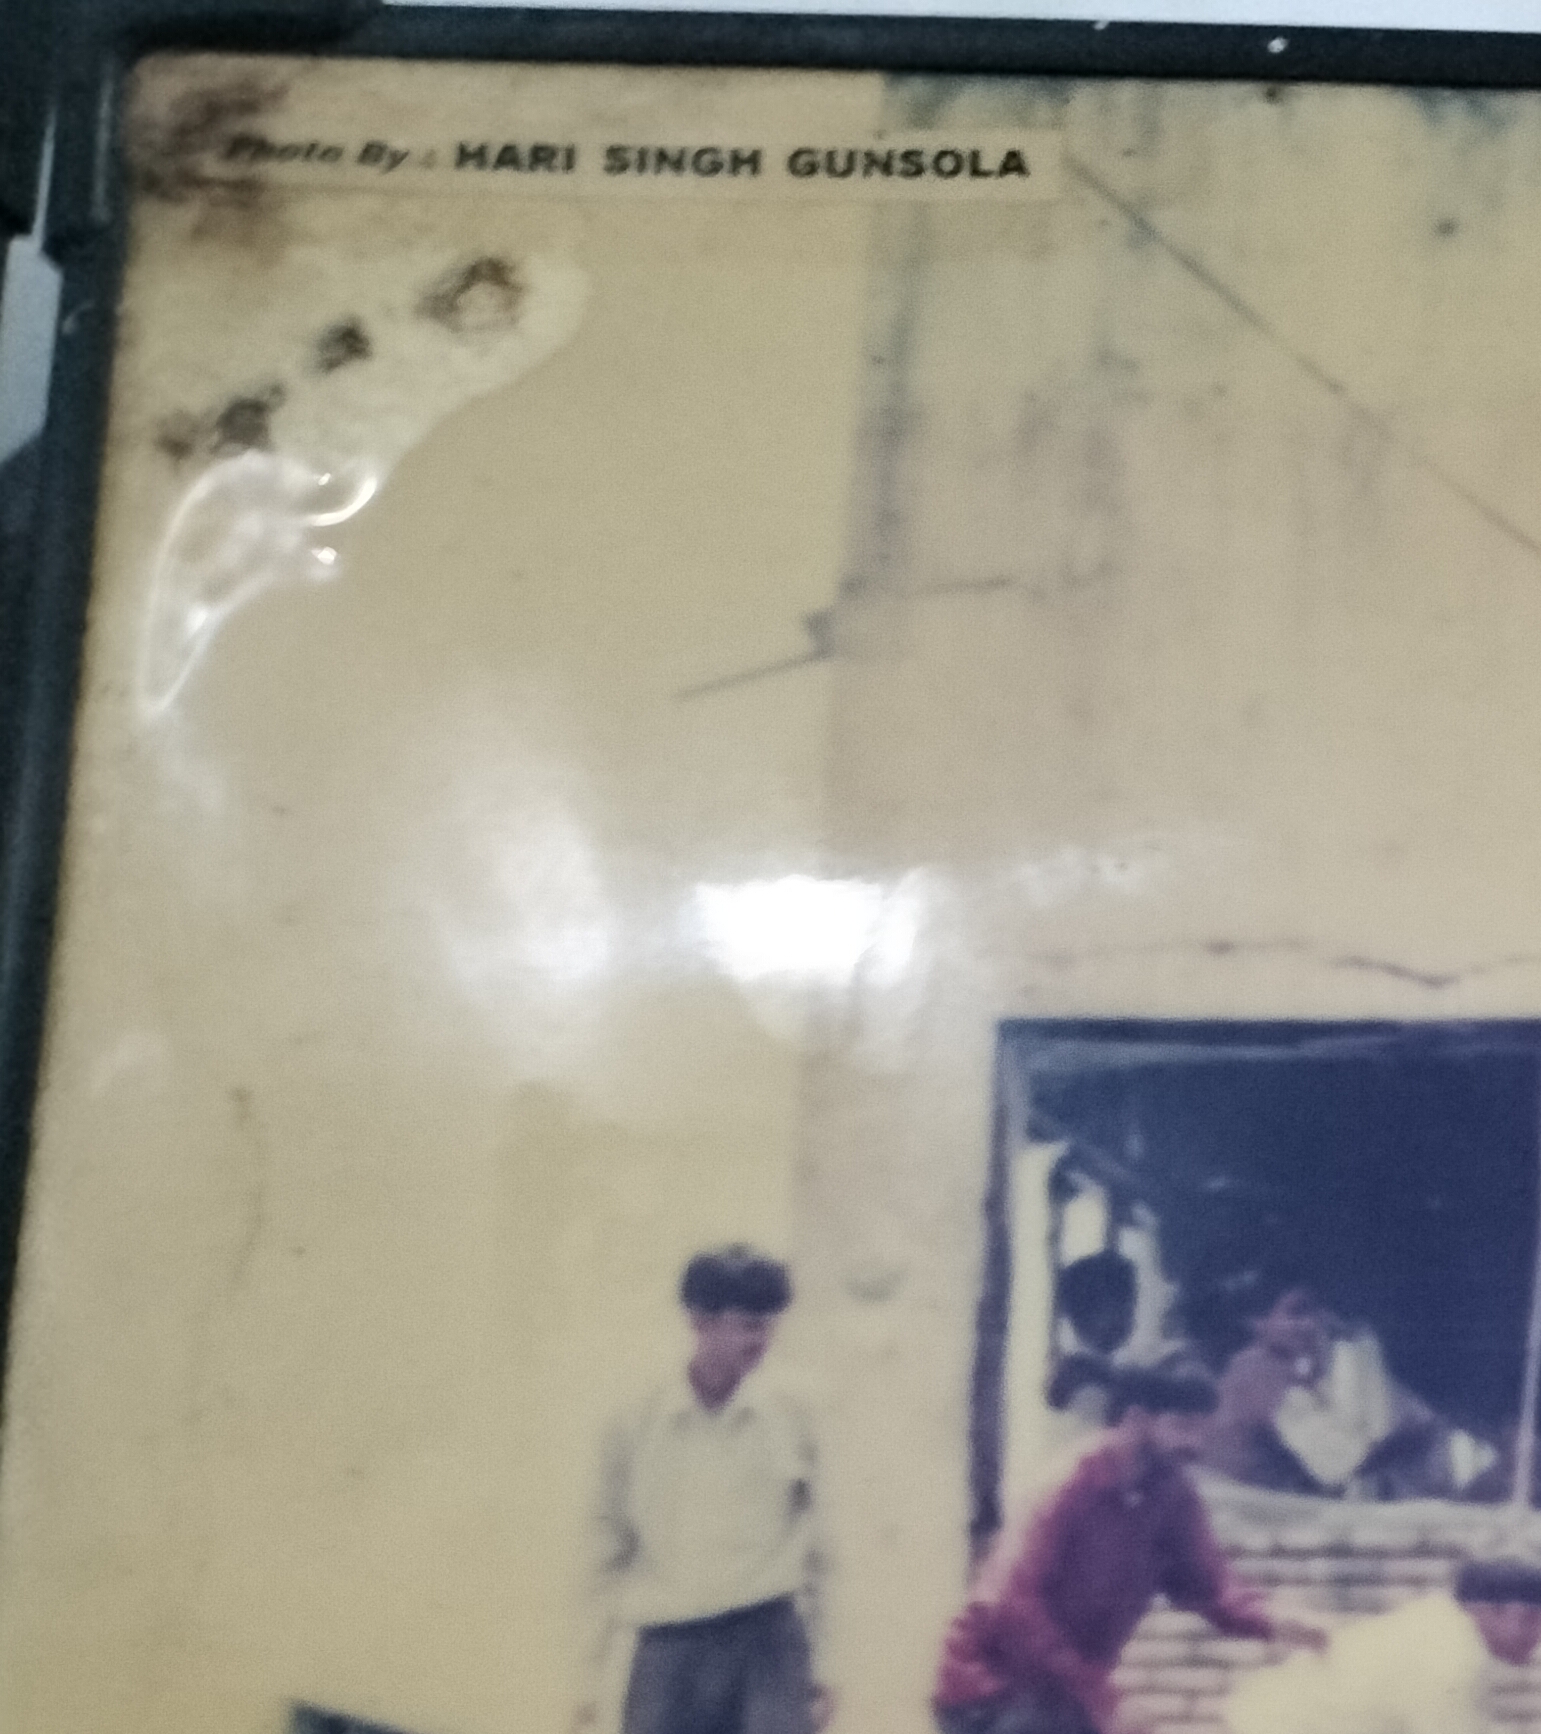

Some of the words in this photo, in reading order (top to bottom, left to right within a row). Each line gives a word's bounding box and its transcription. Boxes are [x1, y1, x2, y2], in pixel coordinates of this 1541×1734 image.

[453, 141, 577, 173] HARI
[602, 143, 763, 178] SINGH
[785, 146, 1029, 180] GUNSOLA
